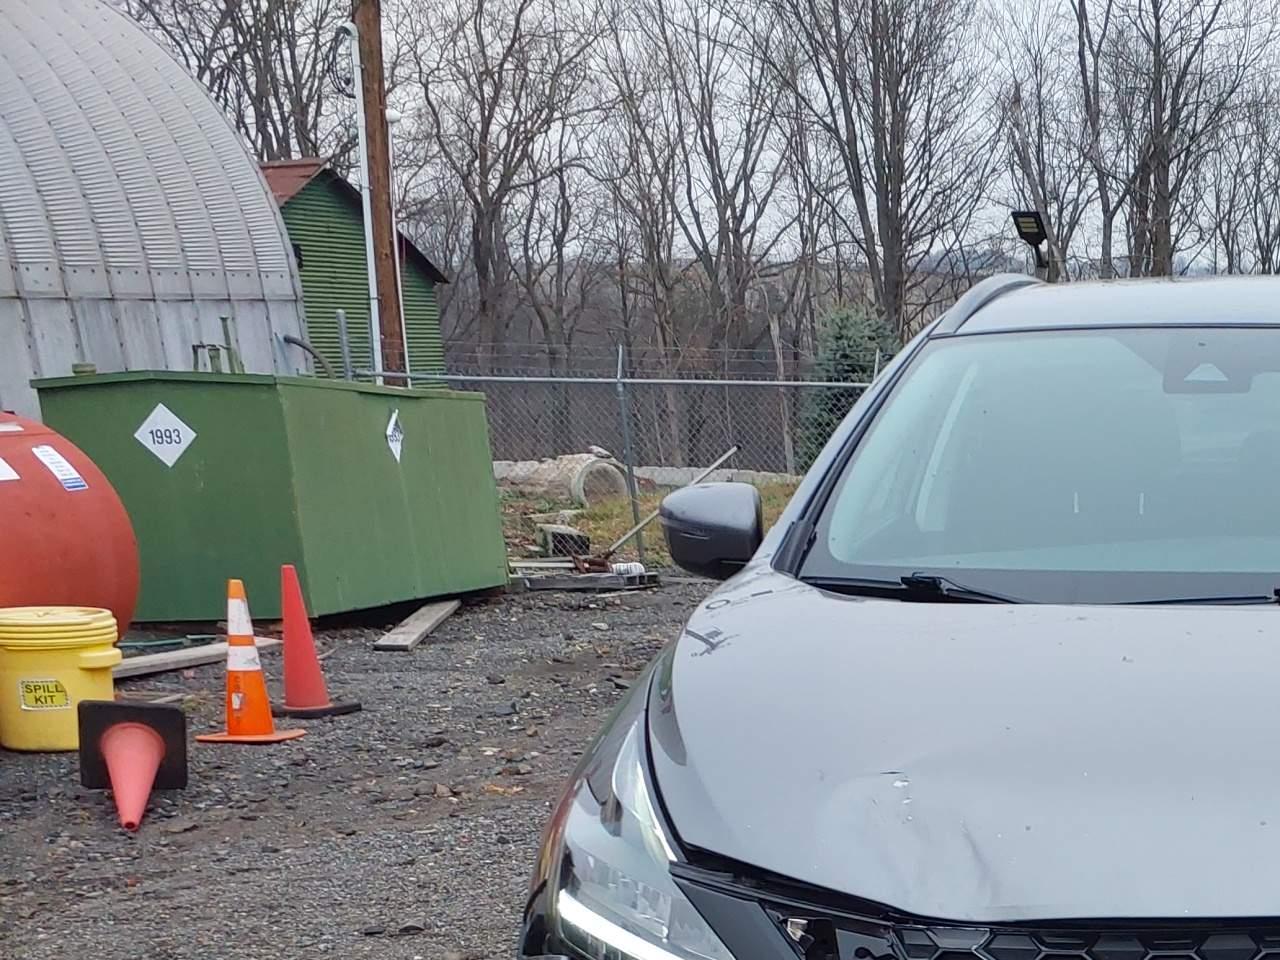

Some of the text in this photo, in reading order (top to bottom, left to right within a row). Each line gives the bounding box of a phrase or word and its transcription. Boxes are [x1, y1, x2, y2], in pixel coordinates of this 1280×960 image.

[149, 428, 182, 445] 1993
[24, 684, 65, 694] SPILL
[34, 694, 56, 705] KIT
